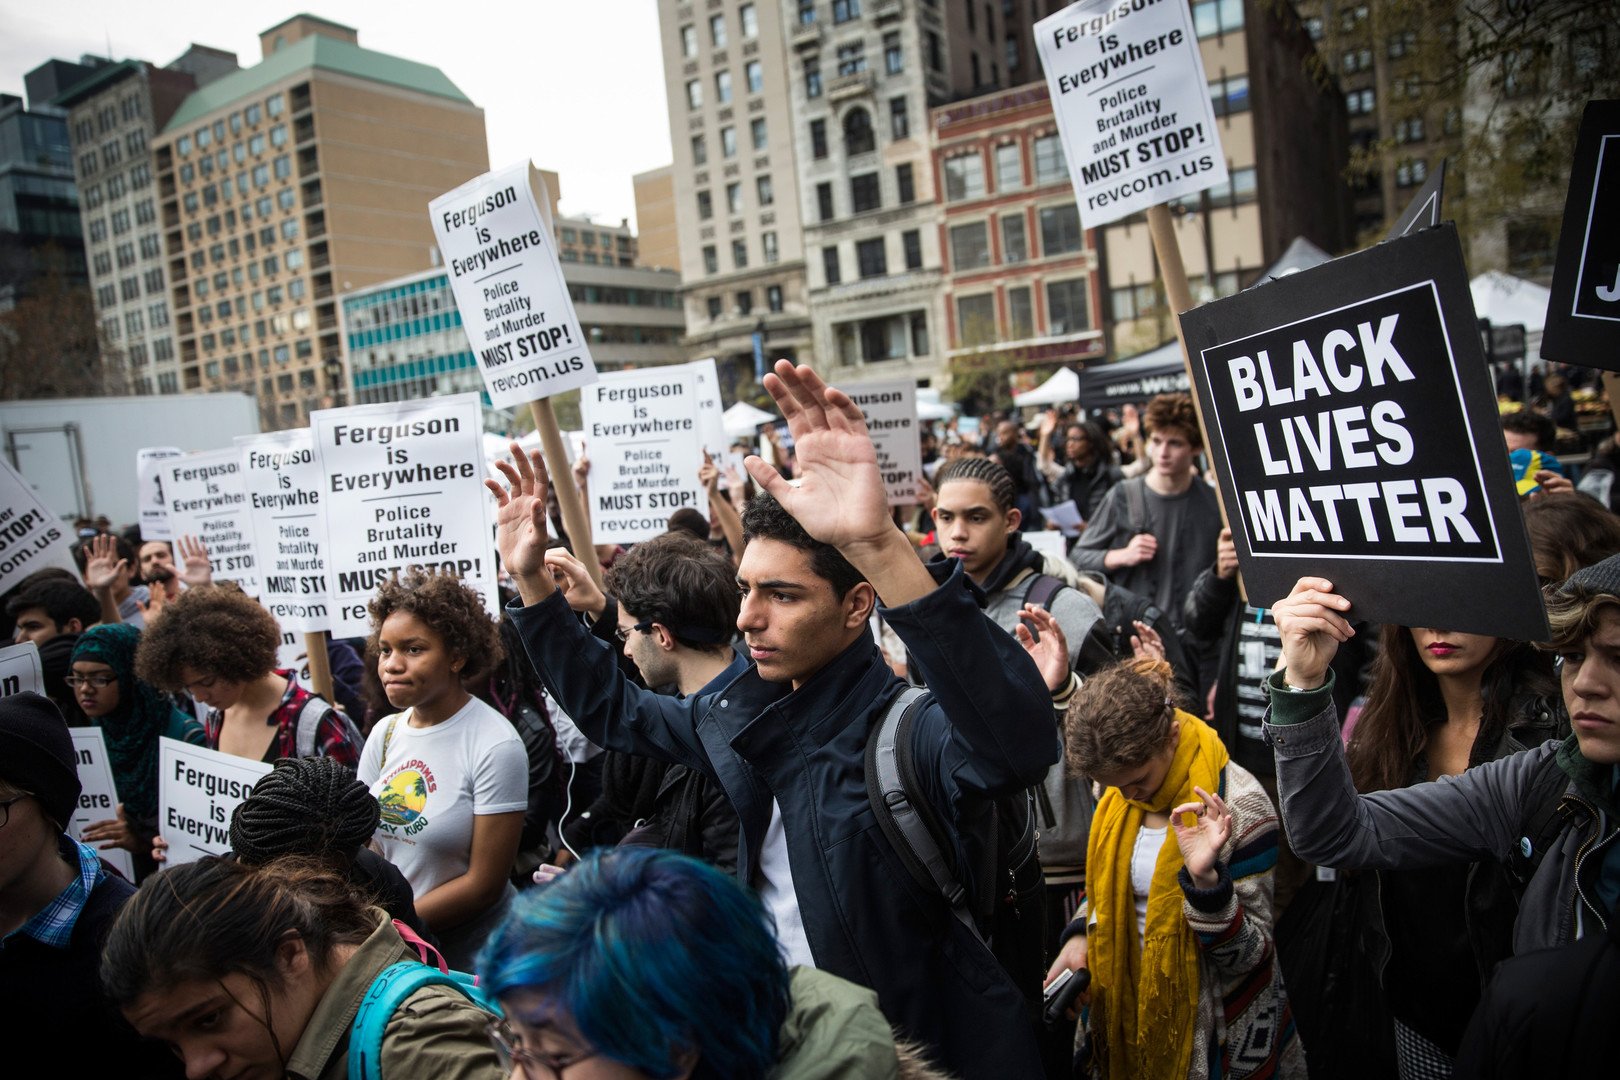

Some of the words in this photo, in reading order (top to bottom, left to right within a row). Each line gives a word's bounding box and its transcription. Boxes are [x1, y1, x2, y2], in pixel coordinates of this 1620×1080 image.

[1099, 33, 1119, 54] is
[1058, 28, 1183, 95] Everywhere
[1099, 82, 1148, 112] Police
[1096, 98, 1162, 133] Brutality
[1093, 132, 1117, 155] and
[1120, 111, 1178, 144] Murder
[1081, 149, 1130, 185] MUST
[1138, 122, 1205, 163] STOP!
[1088, 154, 1214, 210] revcom.us
[443, 186, 517, 232] Ferguson
[475, 227, 491, 245] is
[452, 230, 541, 277] Everywhere
[483, 280, 519, 302] Police
[484, 296, 531, 322] Brutality
[484, 324, 501, 341] and
[502, 312, 545, 335] Murder
[481, 342, 514, 369] MUST
[517, 324, 572, 358] STOP!
[1227, 312, 1416, 413] BLACK
[492, 356, 584, 393] revcom.us
[597, 383, 683, 403] Ferguson
[633, 405, 648, 418] is
[334, 417, 460, 446] Ferguson
[593, 418, 692, 437] Everywhere
[1253, 399, 1415, 476] LIVES
[250, 449, 315, 471] Ferguso
[387, 446, 409, 465] is
[624, 451, 662, 461] Police
[173, 462, 240, 482] Ferguso
[331, 462, 474, 493] Everywhere
[619, 463, 670, 476] Brutality
[206, 482, 219, 494] is
[278, 473, 291, 490] is
[613, 480, 633, 490] and
[637, 477, 680, 488] Murder
[173, 492, 246, 513] Everywhe
[251, 489, 319, 510] Everywhe
[600, 494, 643, 511] MUST
[649, 491, 698, 508] STOP!
[1244, 476, 1481, 544] MATTER
[375, 506, 431, 523] Police
[600, 517, 669, 531] revcom
[203, 521, 234, 531] Police
[279, 525, 309, 539] Police
[367, 523, 443, 543] Brutality
[216, 543, 251, 554] Murder
[278, 541, 319, 555] Brutality
[357, 545, 387, 564] and
[393, 541, 458, 559] Murder
[276, 560, 289, 571] and
[292, 558, 324, 571] Murde
[266, 576, 297, 594] MUST
[270, 604, 328, 618] revcom
[175, 759, 253, 801] Ferguso
[210, 800, 226, 823] is
[167, 807, 230, 845] Everyw
[403, 816, 428, 836] KUBO
